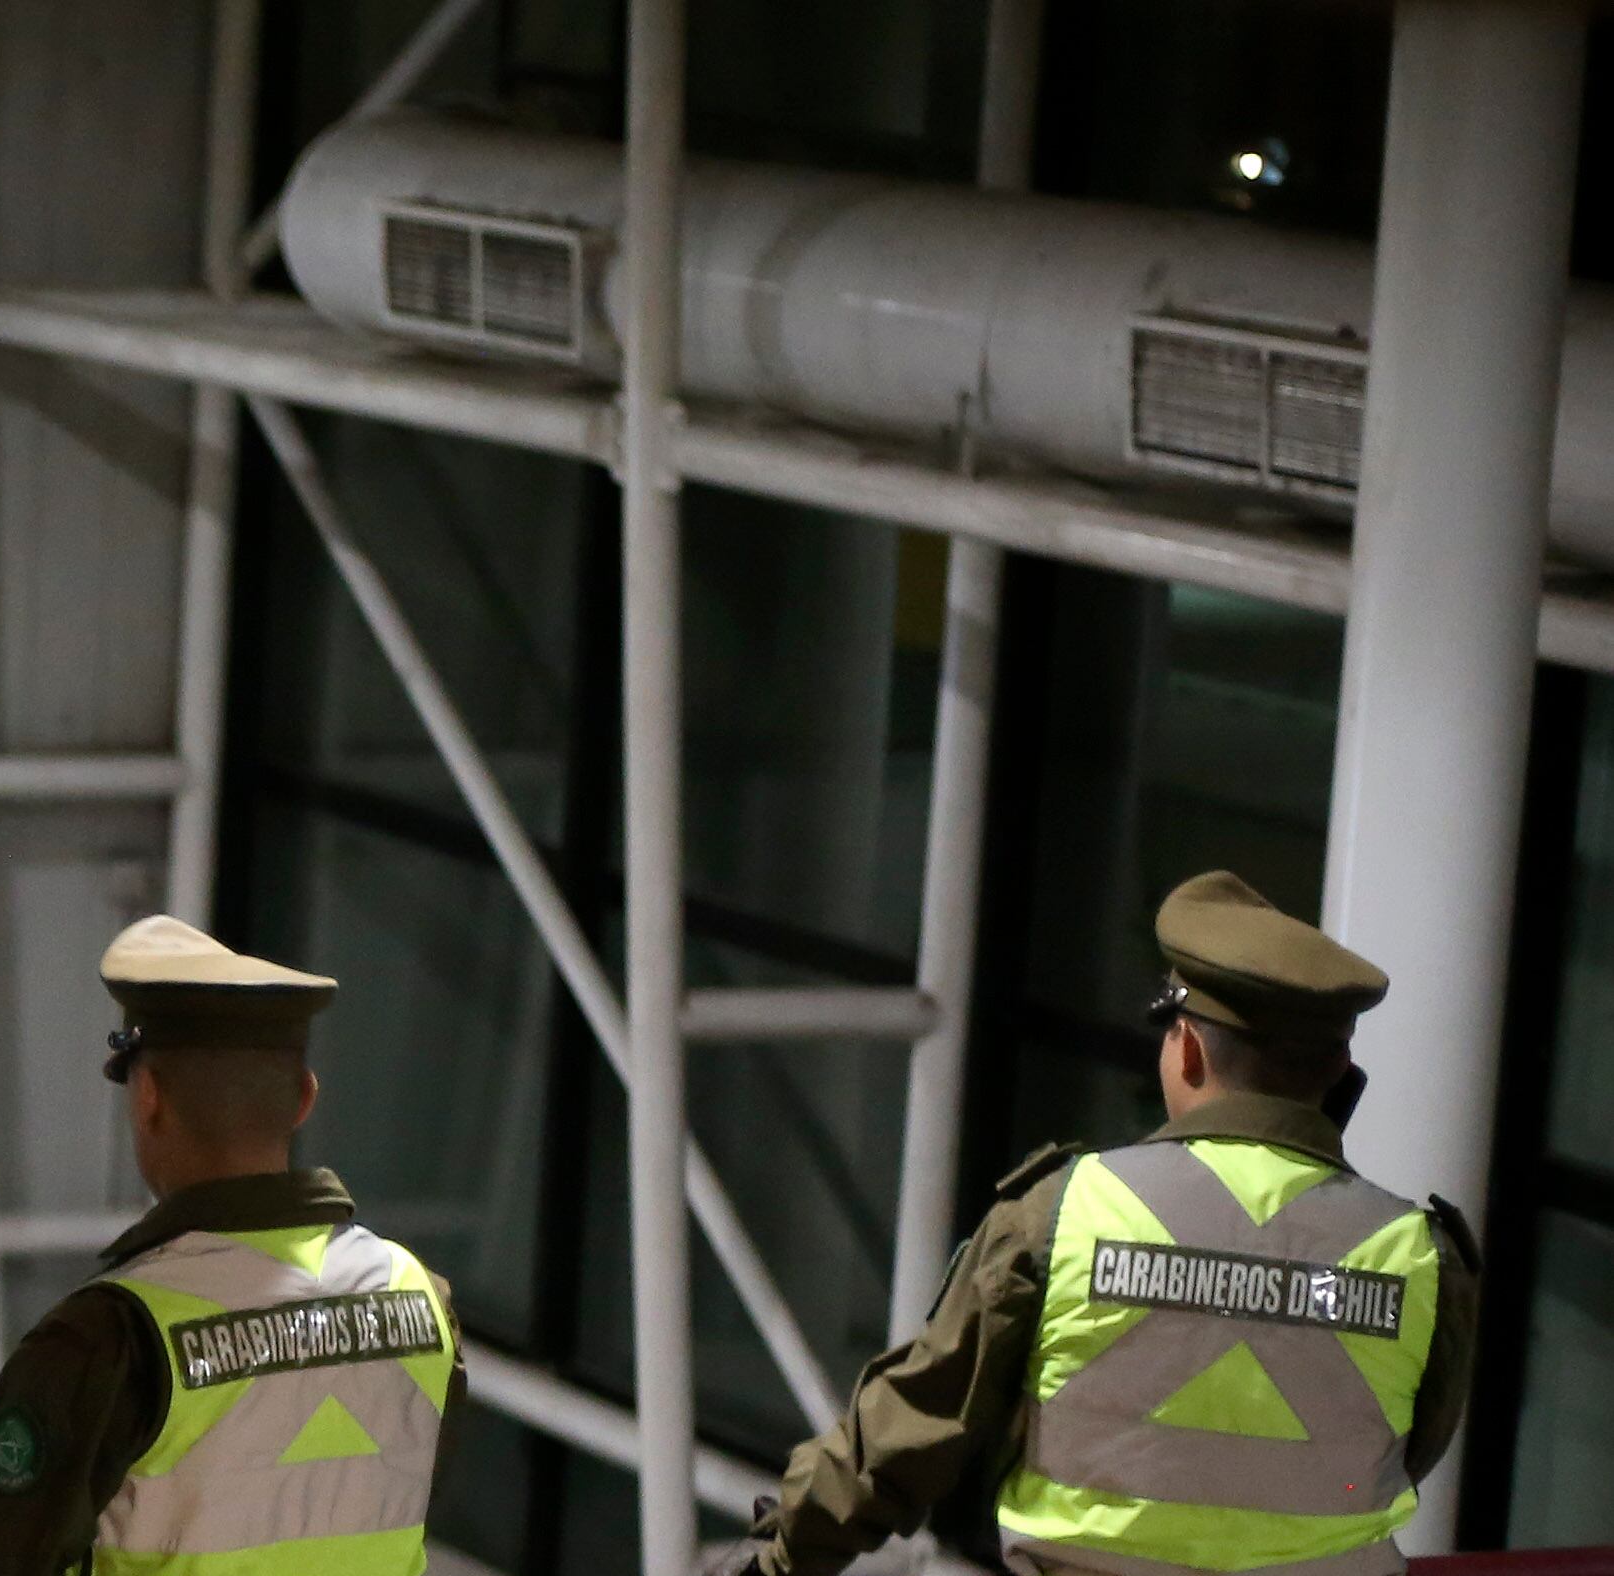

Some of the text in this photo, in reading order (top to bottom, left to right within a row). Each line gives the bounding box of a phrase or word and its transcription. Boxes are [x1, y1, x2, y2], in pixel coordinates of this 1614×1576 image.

[1095, 1246, 1401, 1330] CARABINEROS DE CHILE
[182, 1295, 437, 1380] CARABINEROS DE CHILE
